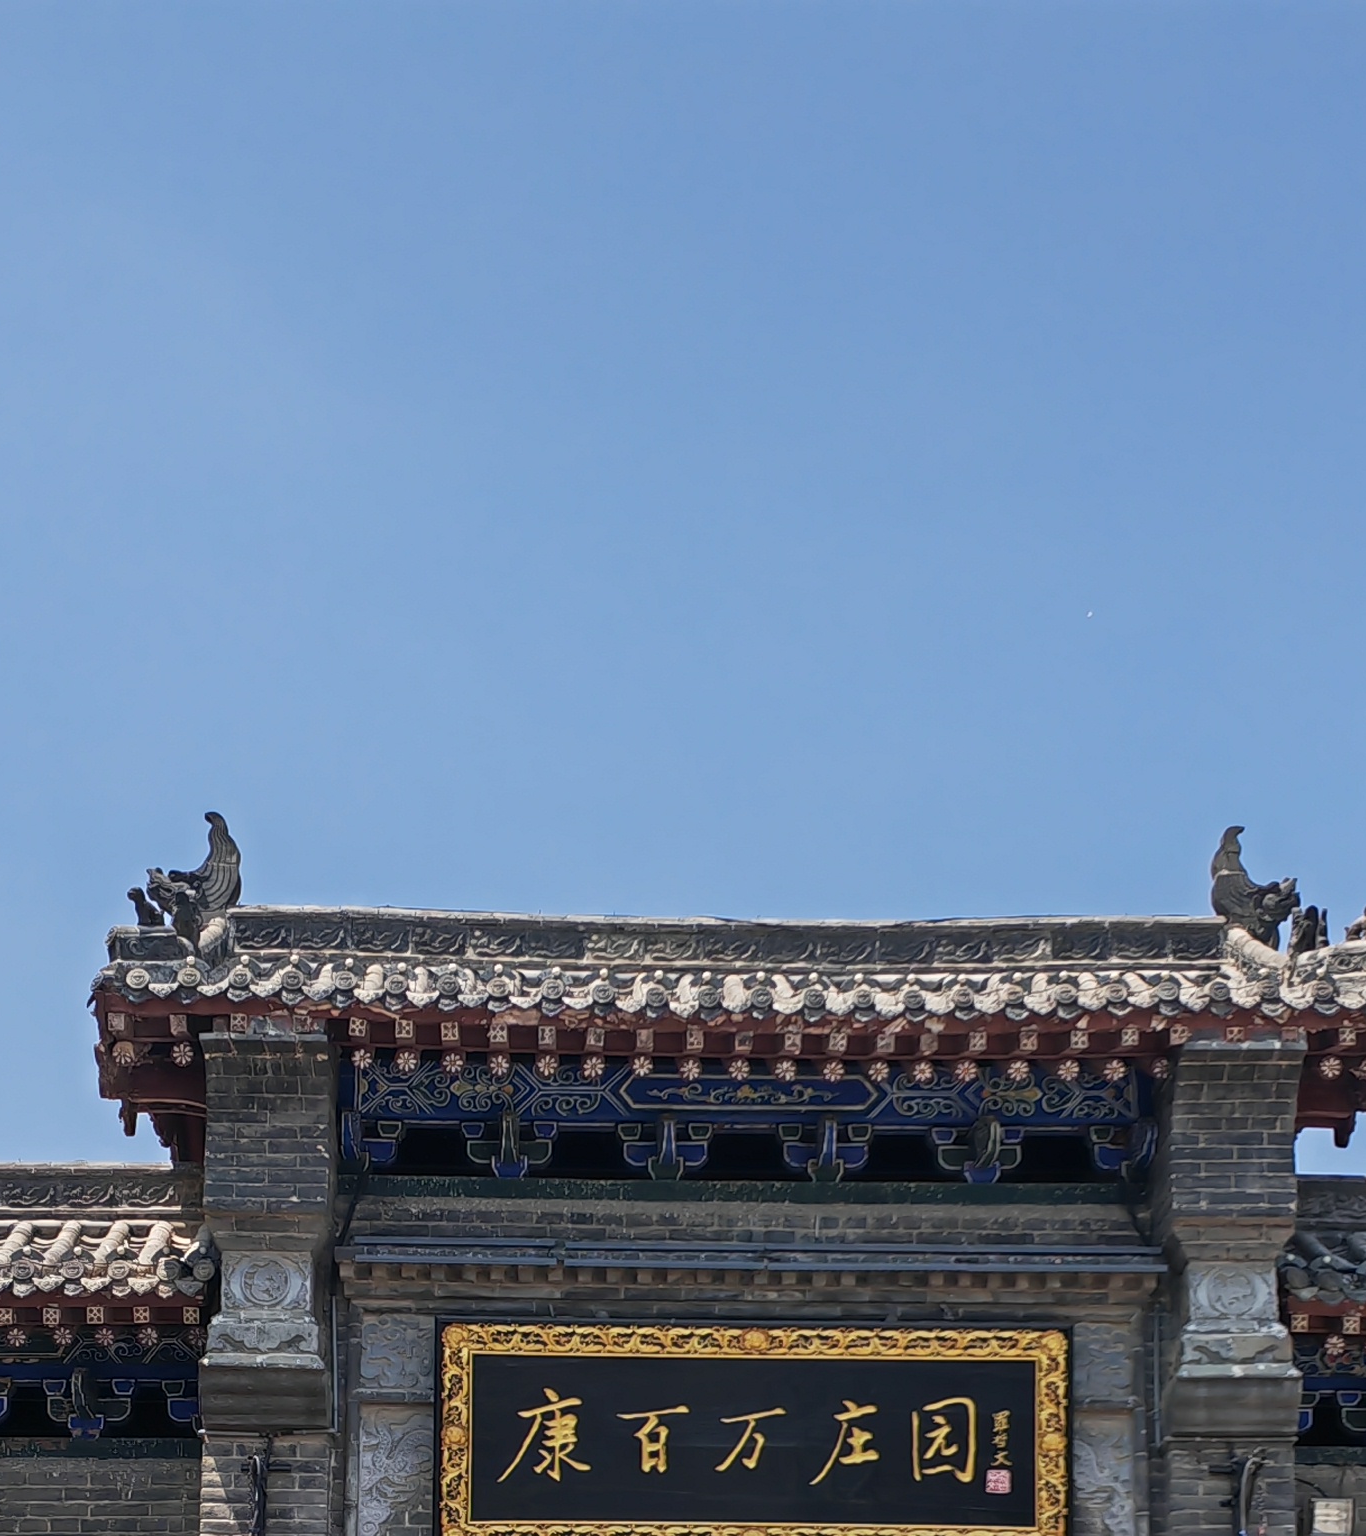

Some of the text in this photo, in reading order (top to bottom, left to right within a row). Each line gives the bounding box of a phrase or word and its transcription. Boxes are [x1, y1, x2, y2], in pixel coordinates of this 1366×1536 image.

[496, 1387, 977, 1485] 康百万庄园
